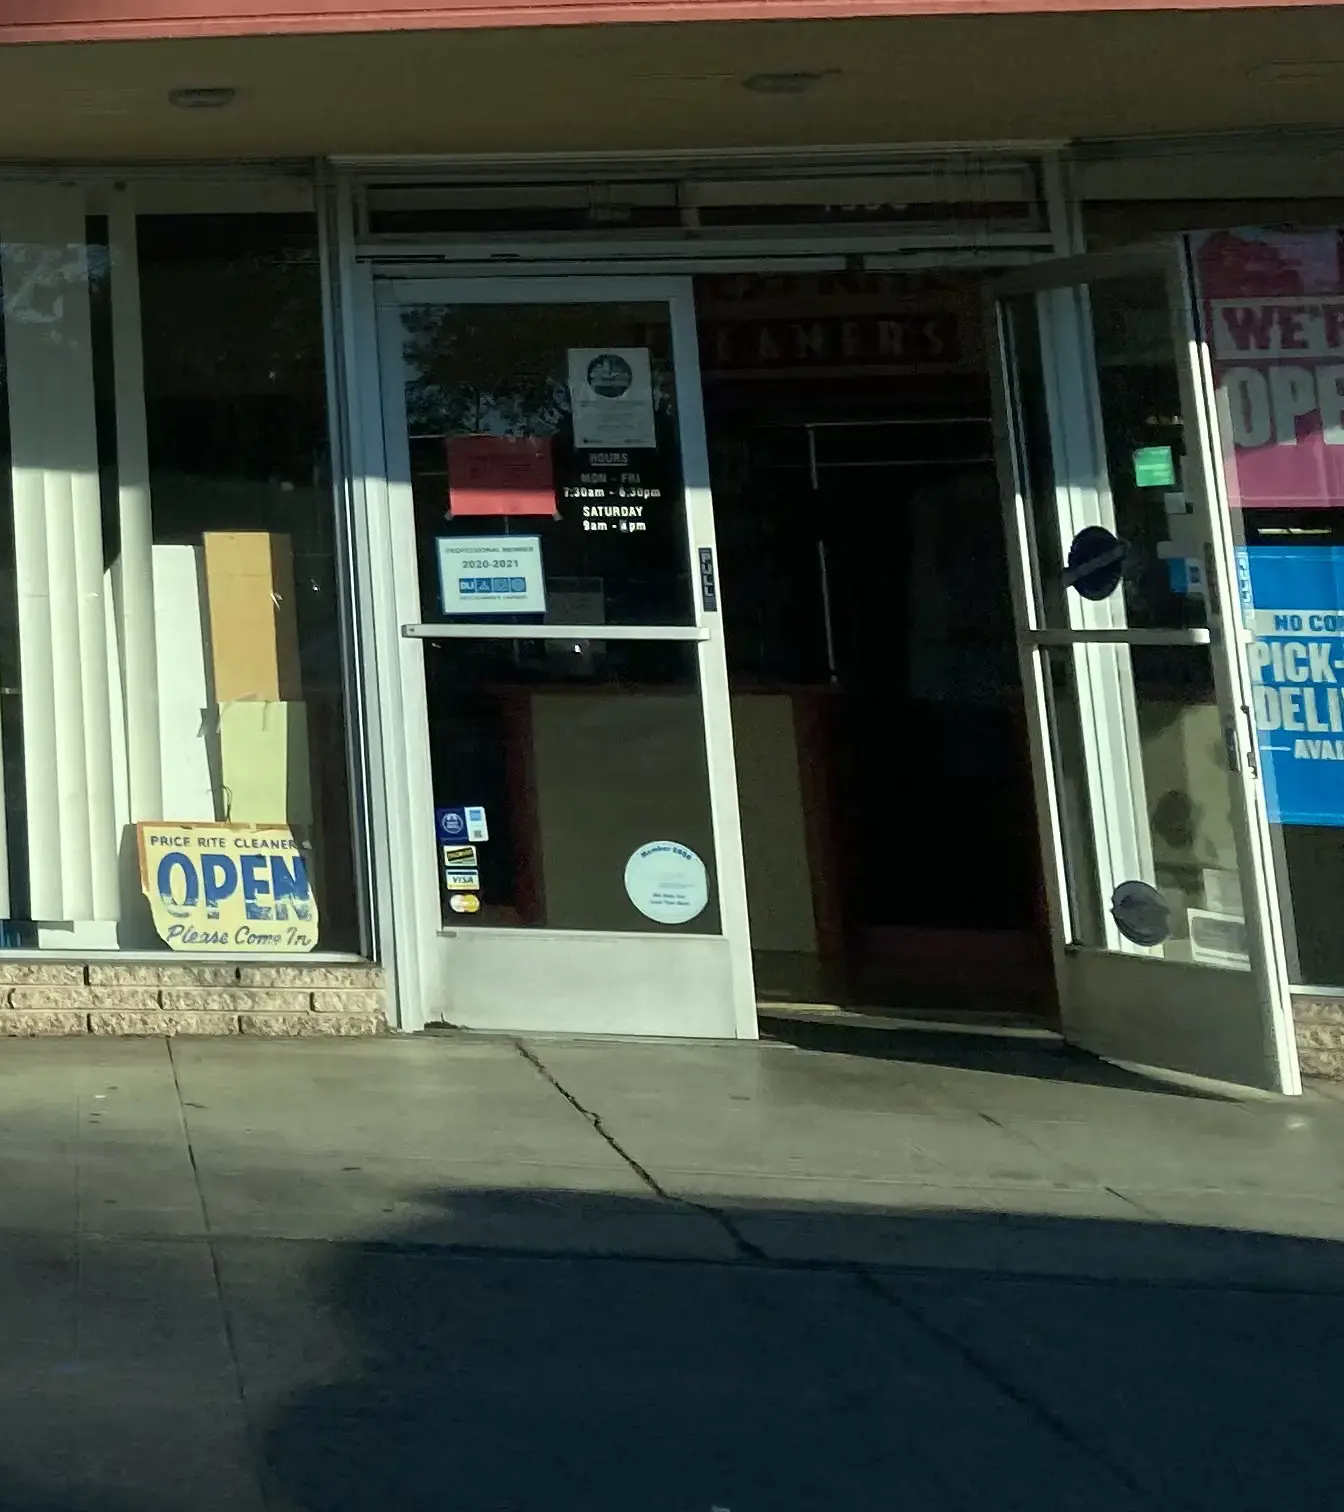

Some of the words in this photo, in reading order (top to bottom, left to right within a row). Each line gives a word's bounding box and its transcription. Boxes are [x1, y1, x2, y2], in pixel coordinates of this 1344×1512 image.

[589, 452, 629, 463] HOURS
[580, 473, 608, 483] MON
[621, 473, 641, 483] FRI
[582, 506, 644, 517] SATURDAY
[582, 520, 608, 531] 9am
[461, 559, 520, 569] 2020-2021
[701, 552, 714, 597] PULL
[1274, 614, 1303, 632] NO
[1253, 686, 1344, 733] DELI
[150, 835, 191, 848] PRICE
[197, 837, 227, 849] RITE
[452, 876, 474, 884] VISA
[157, 851, 312, 922] OPEN
[166, 924, 229, 945] Please
[235, 925, 282, 946] Come
[284, 926, 312, 947] In
